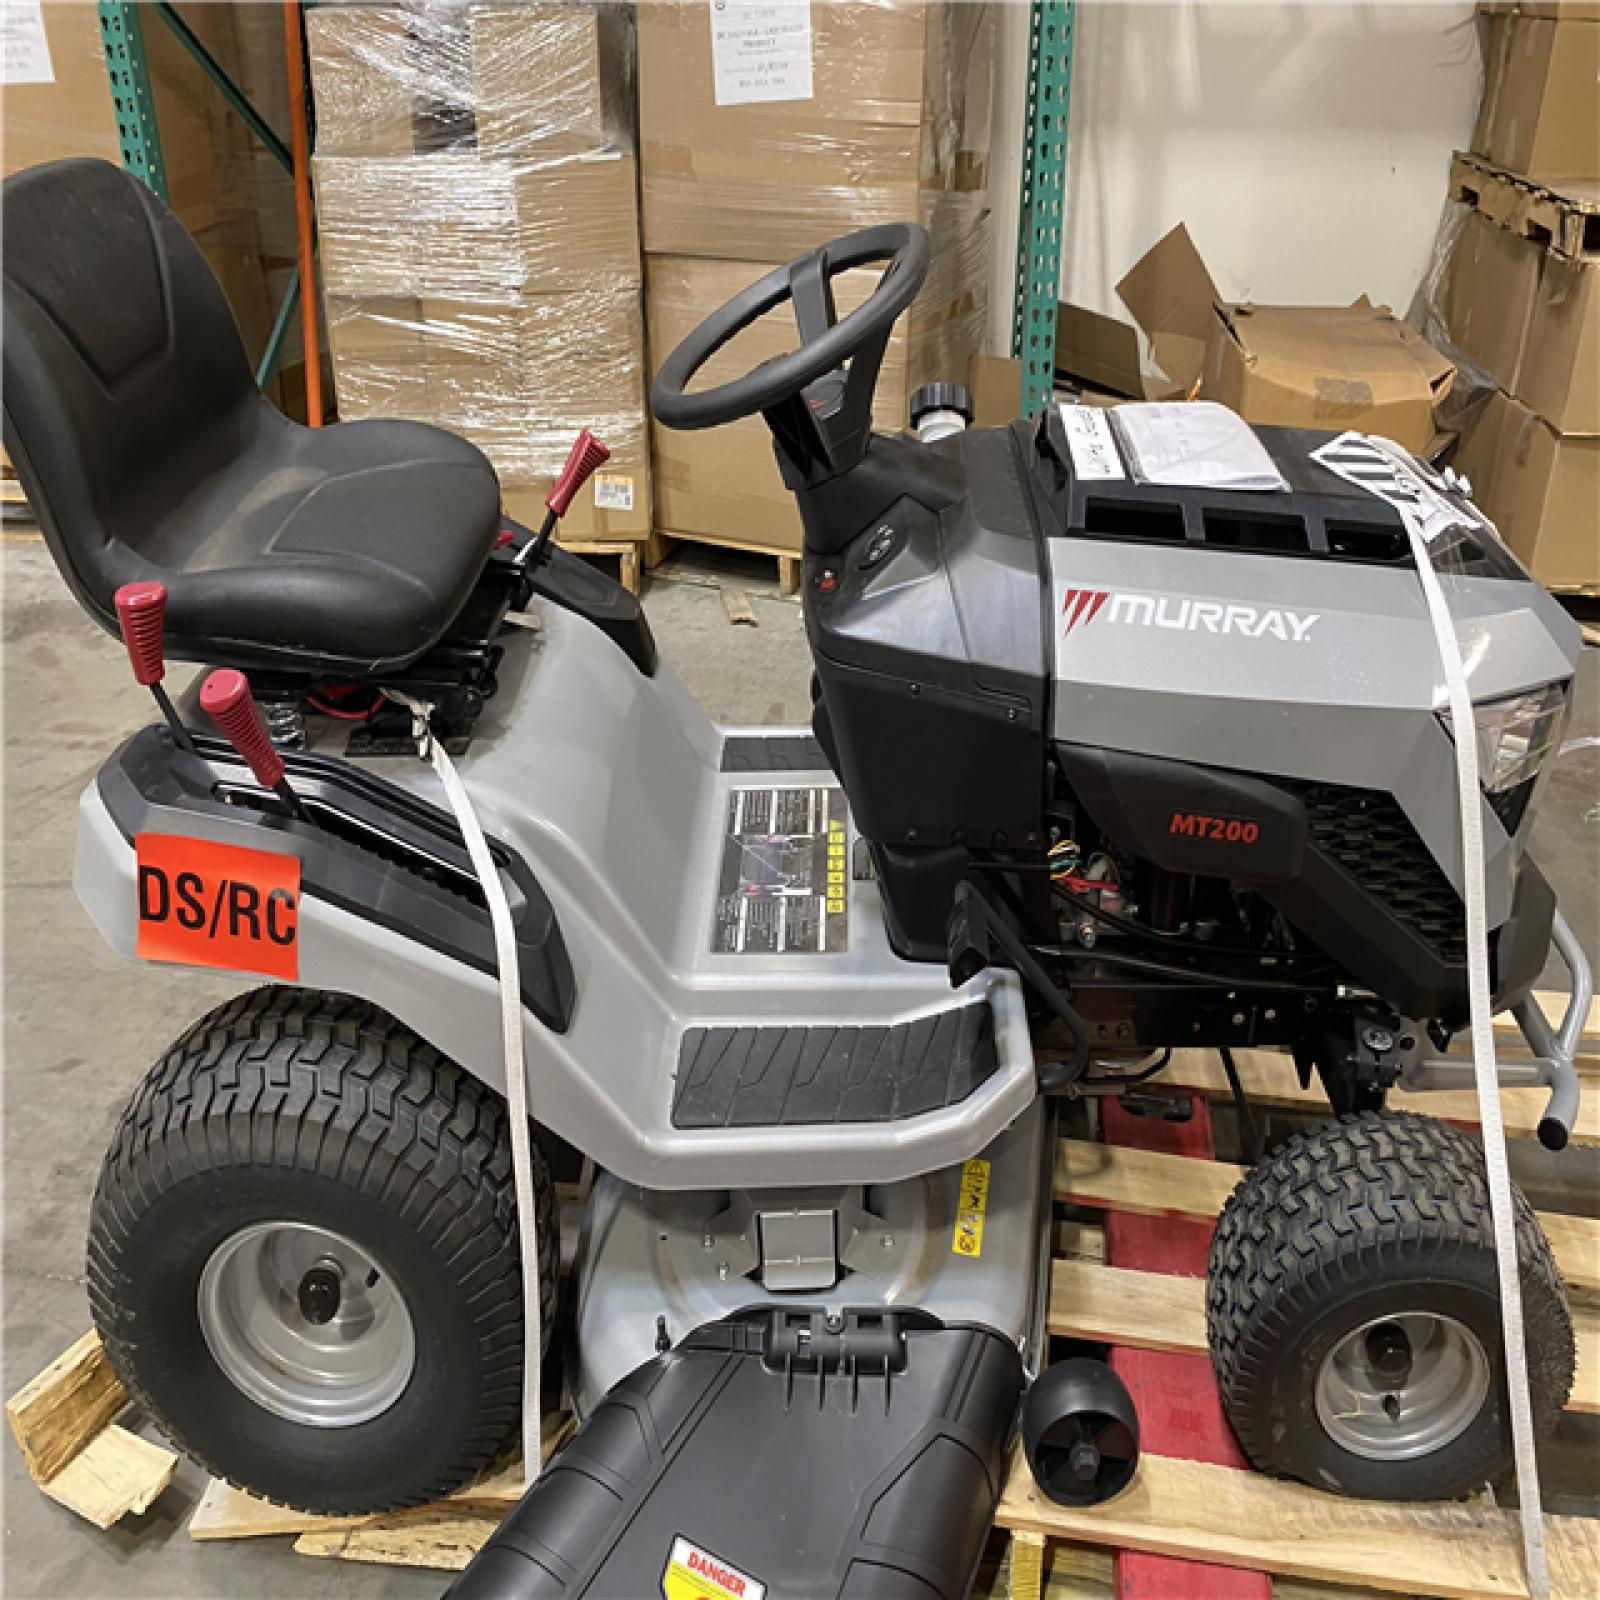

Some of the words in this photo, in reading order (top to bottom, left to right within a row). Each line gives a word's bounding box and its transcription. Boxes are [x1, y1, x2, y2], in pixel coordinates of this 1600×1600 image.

[1106, 593, 1321, 642] MURRAY
[1169, 811, 1259, 844] MT200
[138, 864, 297, 947] DS/RC
[687, 1551, 746, 1598] DANGER
